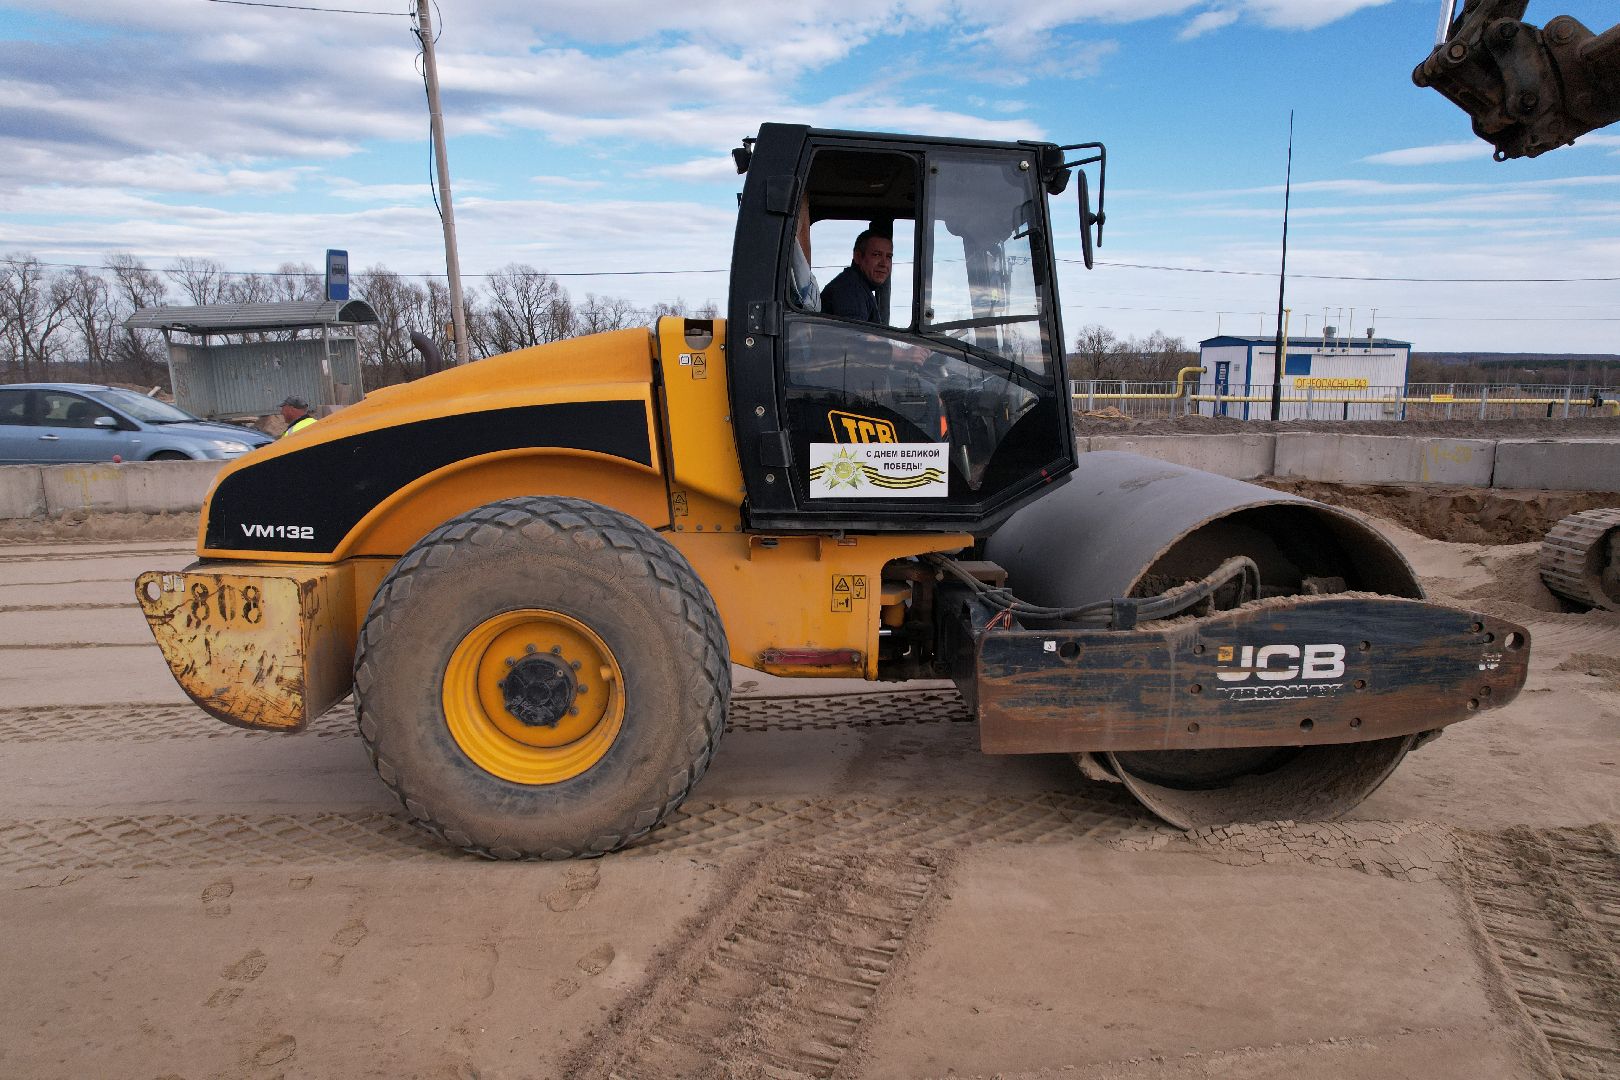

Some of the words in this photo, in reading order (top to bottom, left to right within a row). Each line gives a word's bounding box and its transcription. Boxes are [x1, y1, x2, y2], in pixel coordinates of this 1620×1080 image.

[841, 417, 894, 444] JCB
[866, 450, 872, 458] С
[873, 450, 898, 459] ДНЕМ
[900, 448, 940, 458] ВЕЛИКОЙ
[883, 462, 923, 471] ПОБЕДЫ!
[240, 523, 315, 540] VM132
[1216, 643, 1346, 682] JCB
